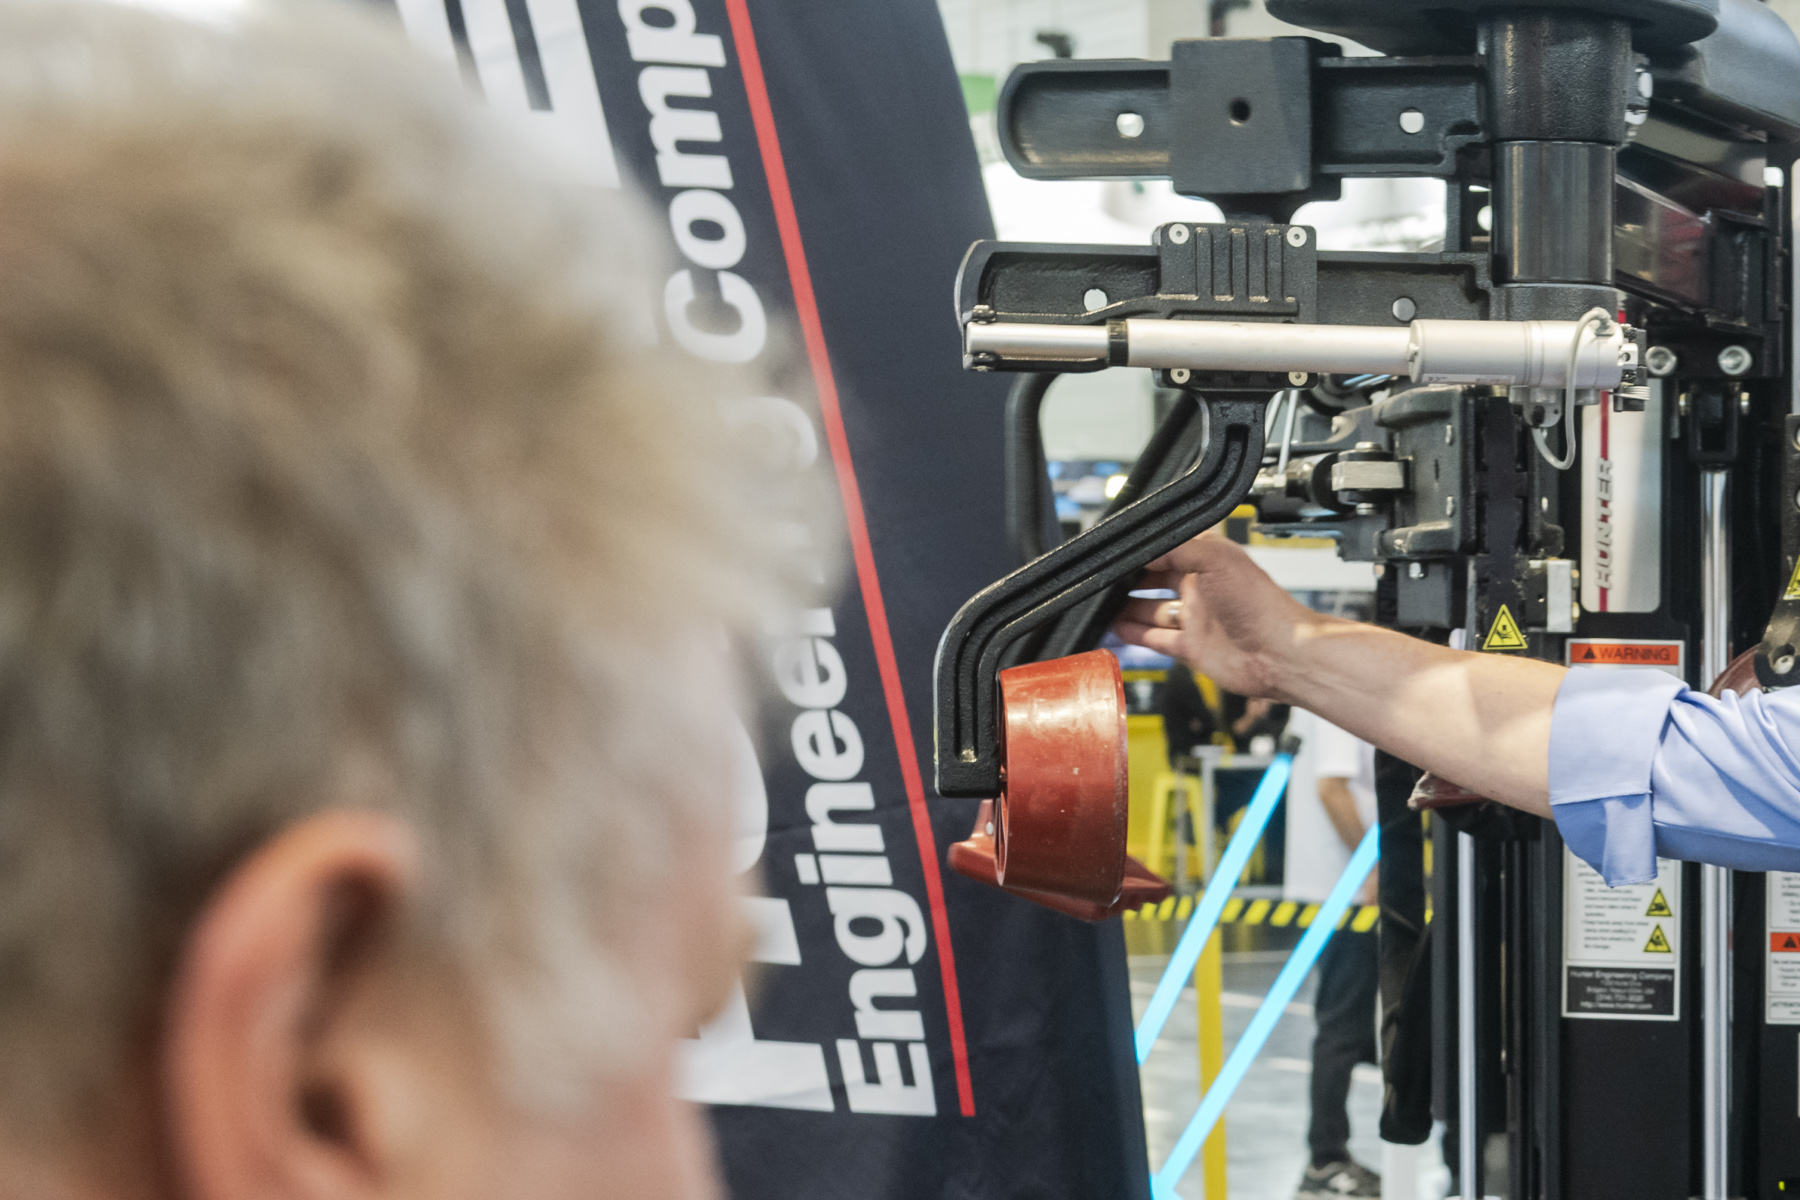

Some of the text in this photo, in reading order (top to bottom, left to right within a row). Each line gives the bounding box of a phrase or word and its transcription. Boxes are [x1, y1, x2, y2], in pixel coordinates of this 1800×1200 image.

[617, 0, 767, 363] Comp
[1595, 456, 1613, 589] HUNTER
[1600, 647, 1670, 660] WARNING
